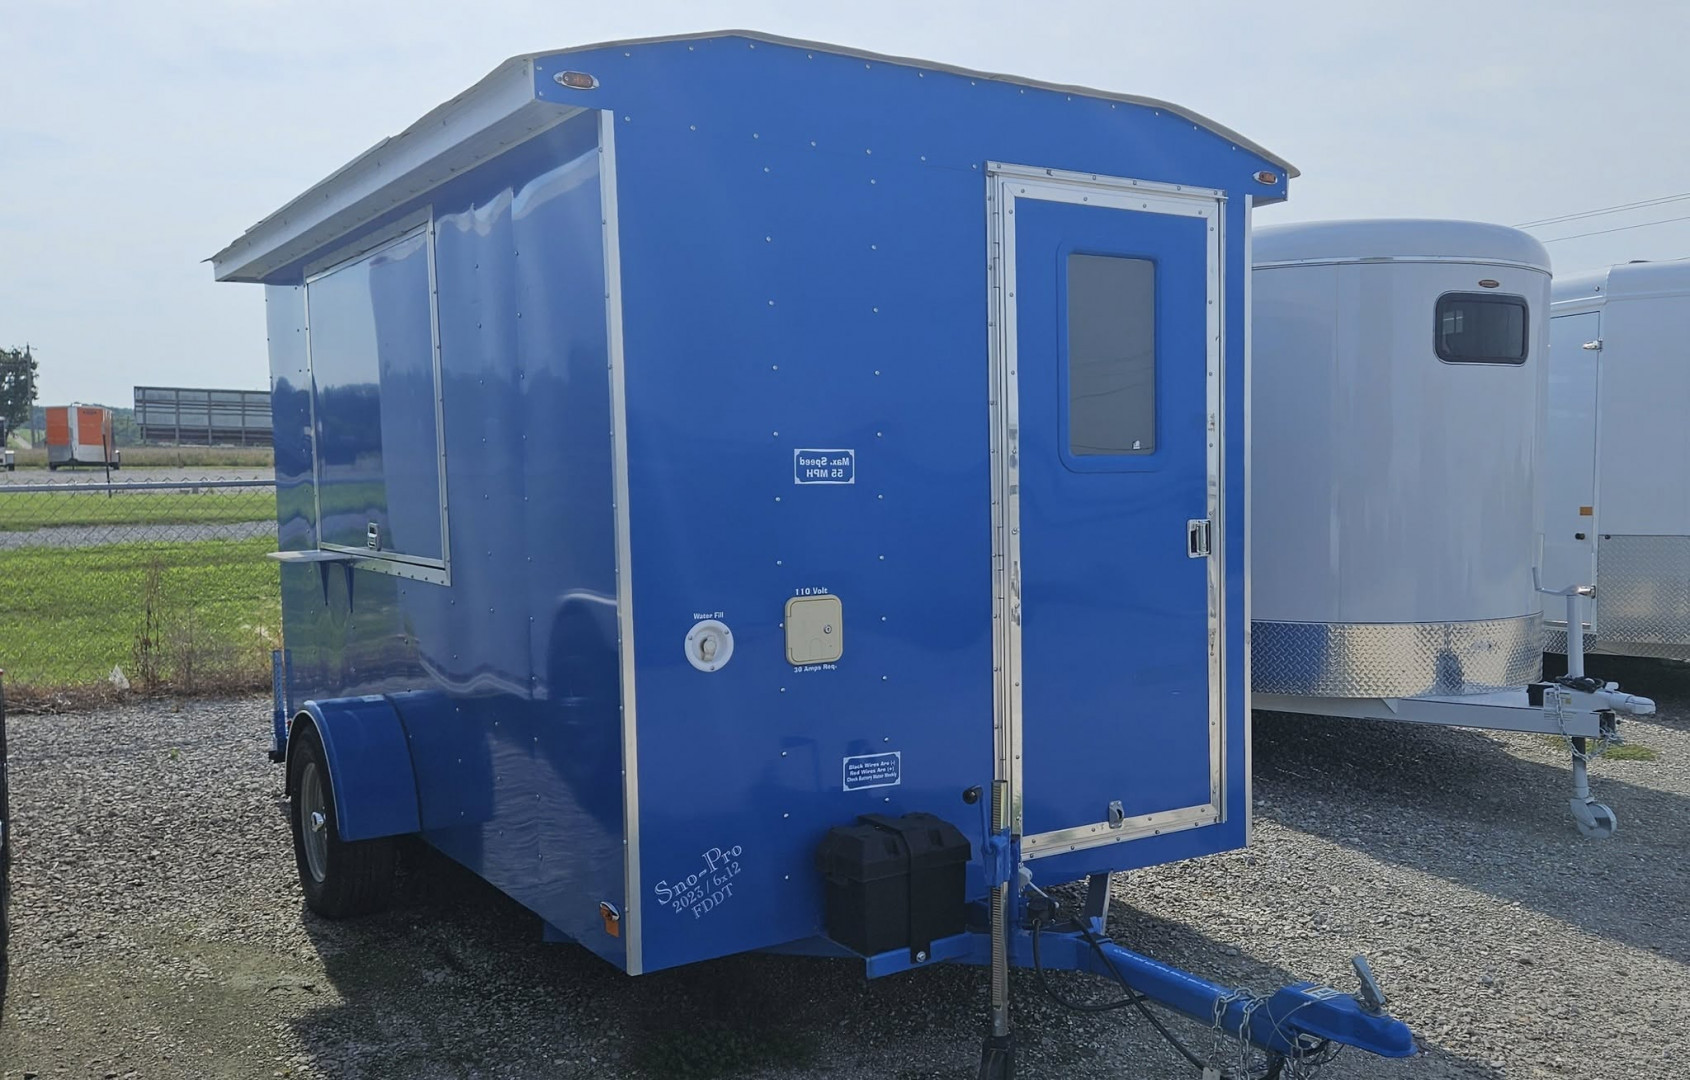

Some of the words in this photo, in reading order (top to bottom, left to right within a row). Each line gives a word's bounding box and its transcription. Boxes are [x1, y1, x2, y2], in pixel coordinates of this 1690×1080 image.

[795, 587, 811, 596] 110
[812, 586, 828, 595] Volt
[693, 612, 713, 620] Water
[714, 611, 724, 619] Fill
[804, 665, 822, 673] Amps
[654, 845, 743, 906] Sno-Pro
[672, 885, 704, 914] 2023
[712, 861, 742, 887] 6x12
[691, 882, 734, 920] FDDT
